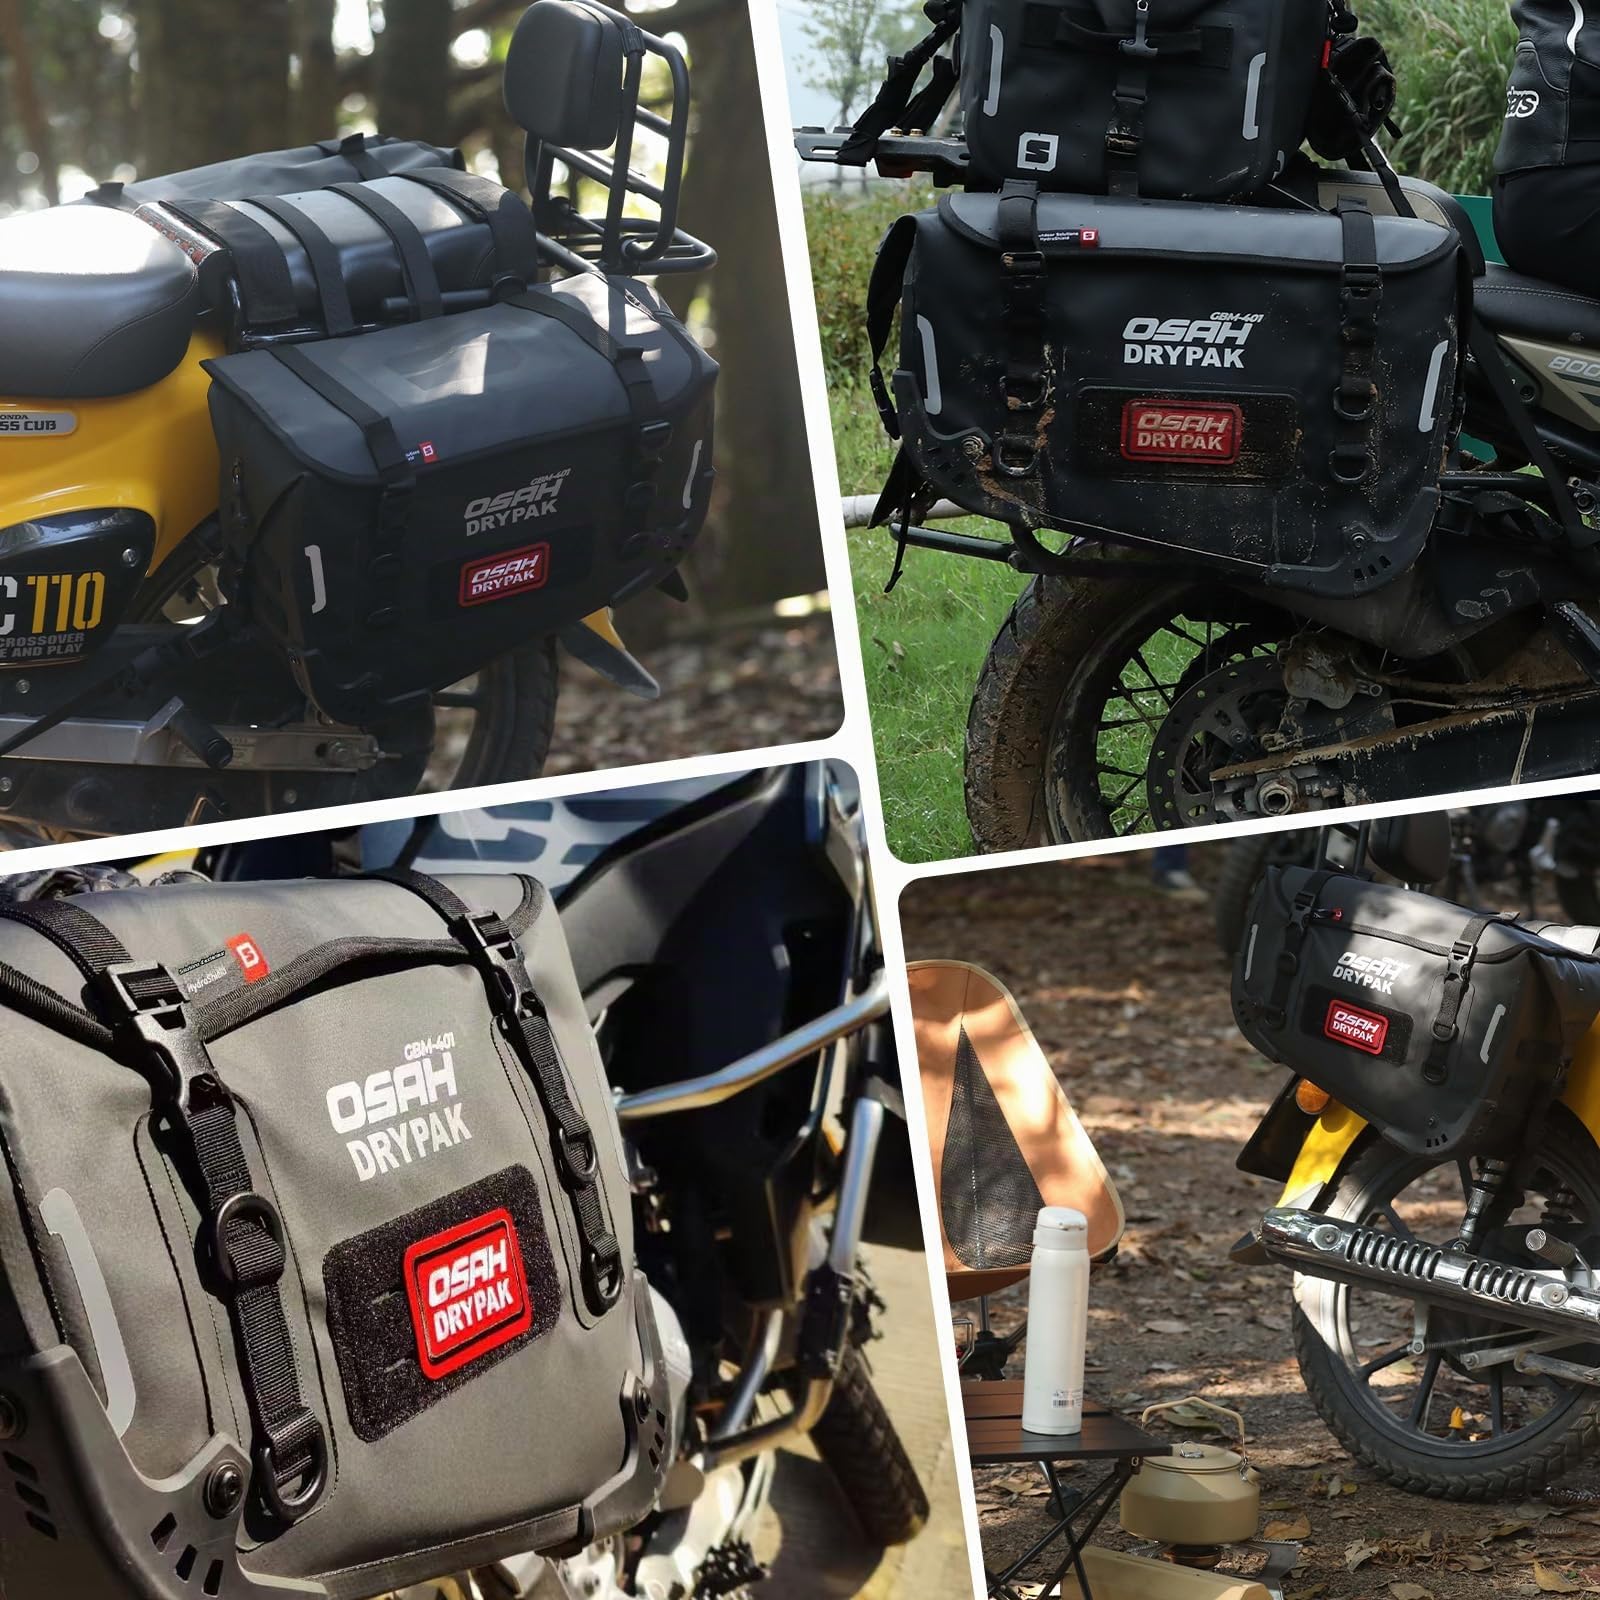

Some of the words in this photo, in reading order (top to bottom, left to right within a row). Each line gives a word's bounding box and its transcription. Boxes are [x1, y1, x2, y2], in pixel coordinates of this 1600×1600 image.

[1209, 311, 1265, 323] GBM-401
[1122, 317, 1253, 345] OSAH
[1124, 343, 1245, 369] DRYPAK
[0, 420, 20, 431] SS
[23, 420, 57, 431] CUB
[1137, 413, 1229, 433] OSAH
[1137, 432, 1223, 451] DRYPAK
[530, 467, 571, 486] GBM-401
[464, 478, 563, 519] OSAH
[466, 499, 558, 537] DRYPAK
[472, 554, 539, 584] OSAH
[472, 569, 535, 595] DRYPAK
[0, 648, 7, 658] E
[11, 646, 43, 658] AND
[46, 643, 83, 656] PLAY
[1337, 951, 1402, 980] OSAH
[1332, 965, 1394, 995] DRYPAK
[1332, 1020, 1374, 1043] DRYPAK
[1334, 1010, 1380, 1034] OSAH
[326, 1051, 458, 1134] OSAH
[346, 1102, 473, 1182] DRYPAK
[428, 1239, 508, 1308] OSAH
[433, 1277, 514, 1343] DRYPAK
